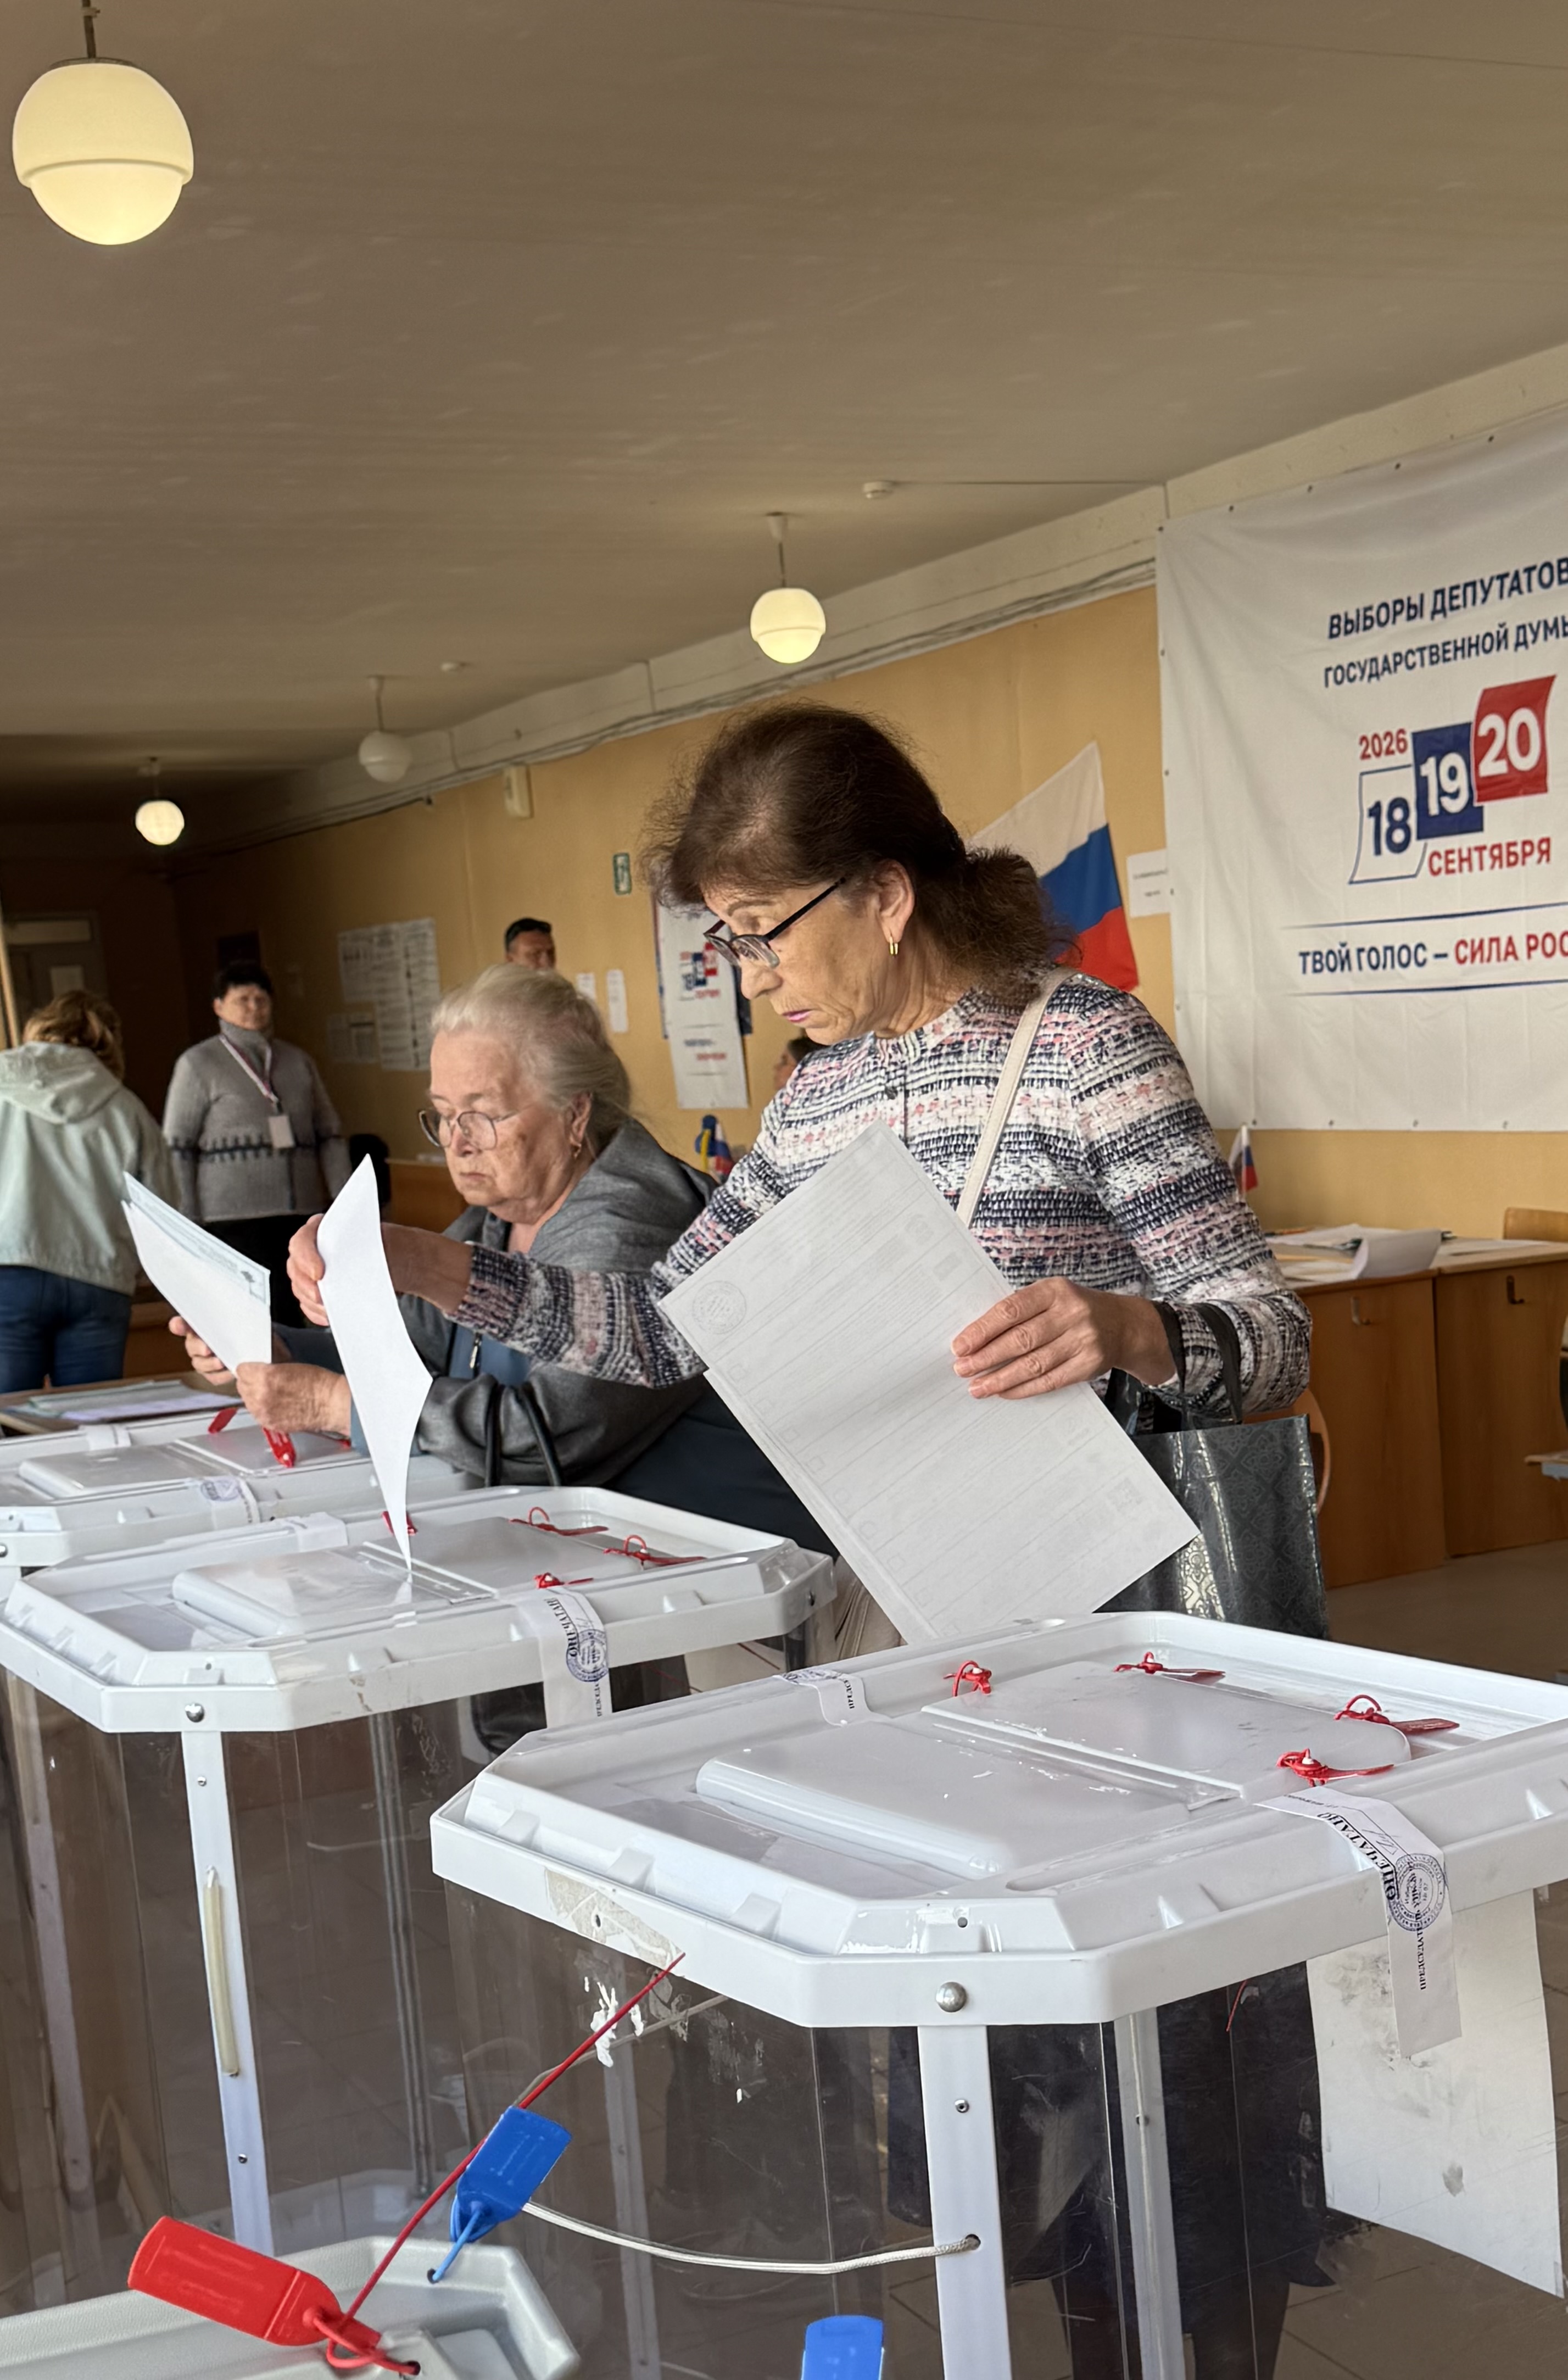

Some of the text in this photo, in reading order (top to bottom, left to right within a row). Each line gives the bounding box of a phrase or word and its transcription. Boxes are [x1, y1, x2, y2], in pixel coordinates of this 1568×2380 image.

[1328, 557, 1568, 639] ВЫБОРЫ ДЕПУТАТОВ
[1325, 622, 1508, 688] ГОСУДАРСТВЕННОЙ
[1359, 729, 1408, 760] 2026
[1368, 707, 1541, 856] 18 19 20
[1429, 837, 1551, 876] СЕНТЯБРЯ
[1299, 942, 1352, 974] ТВОЙ
[1357, 943, 1427, 971] ГОЛОС
[1455, 936, 1519, 965] СИЛА
[1317, 1812, 1396, 1900] ОПЕЧАТАНО
